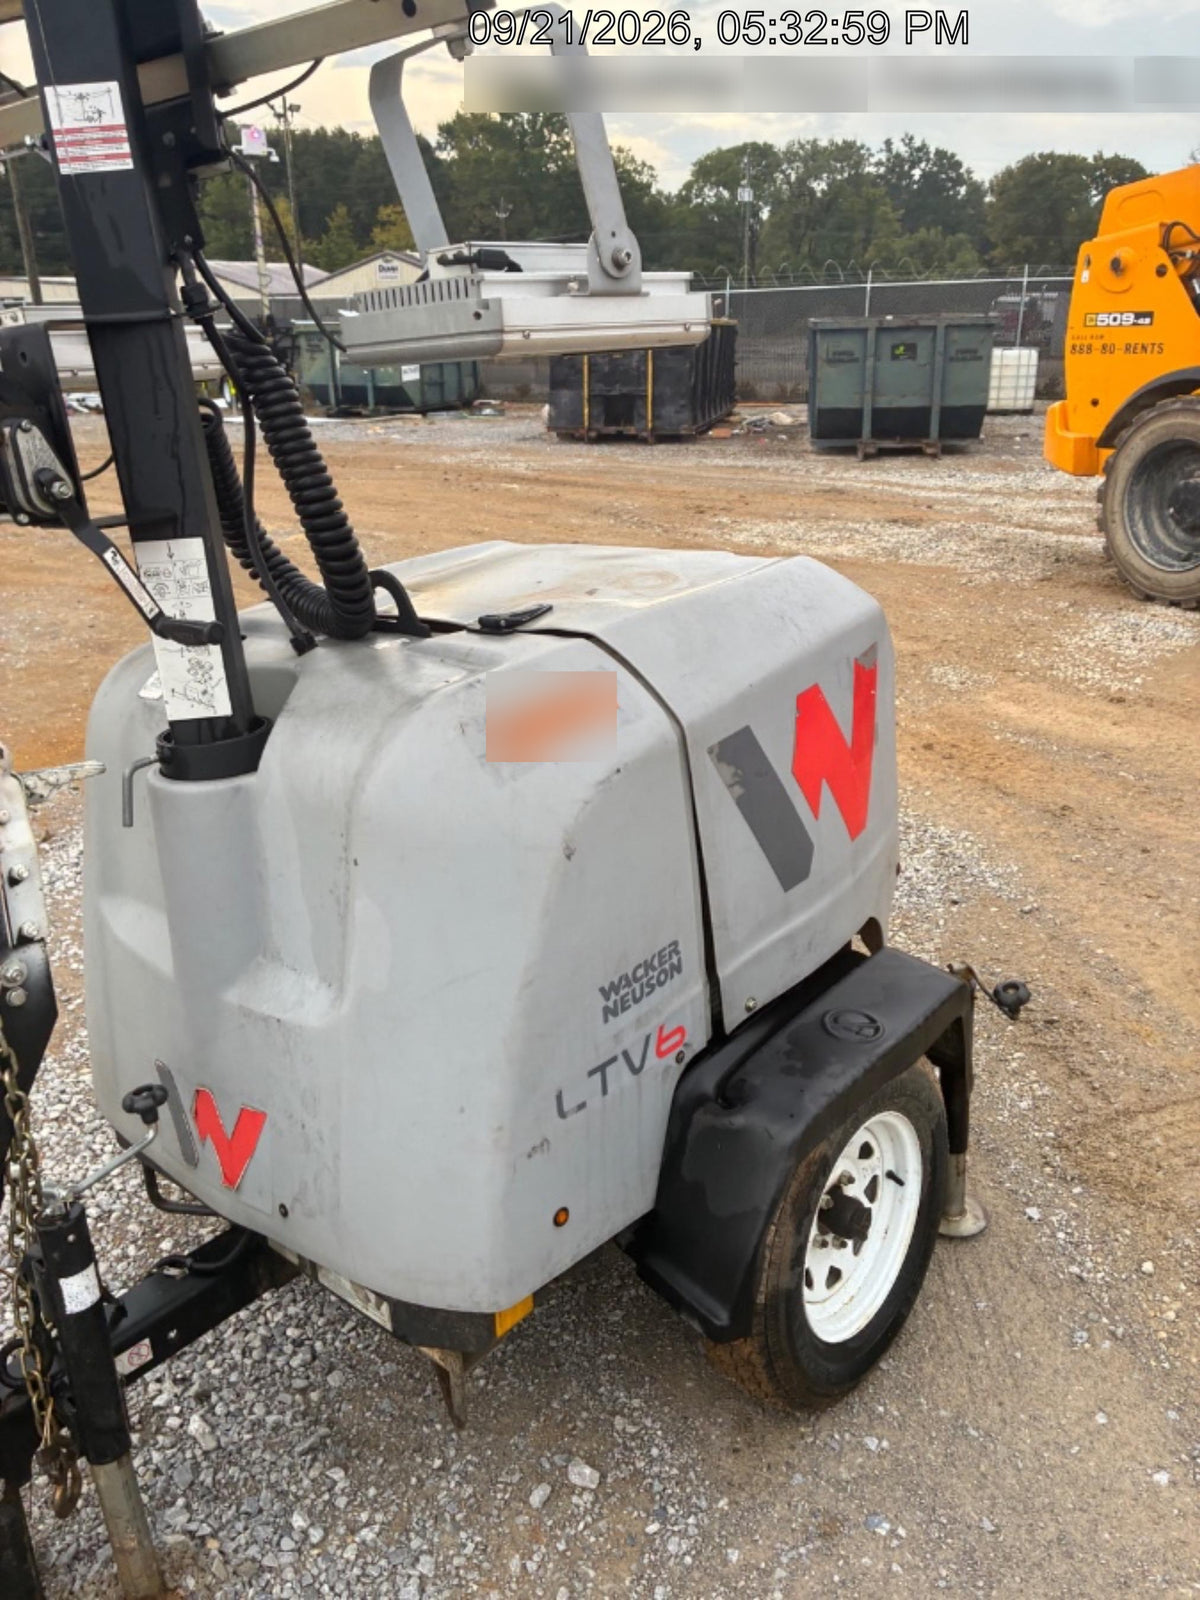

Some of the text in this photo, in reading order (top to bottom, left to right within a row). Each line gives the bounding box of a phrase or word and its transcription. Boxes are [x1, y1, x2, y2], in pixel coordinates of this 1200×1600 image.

[1070, 342, 1165, 355] 888-80-RENTS
[599, 939, 681, 1003] WACKER
[602, 956, 683, 1024] NEUSON
[555, 1023, 687, 1120] LTV6
